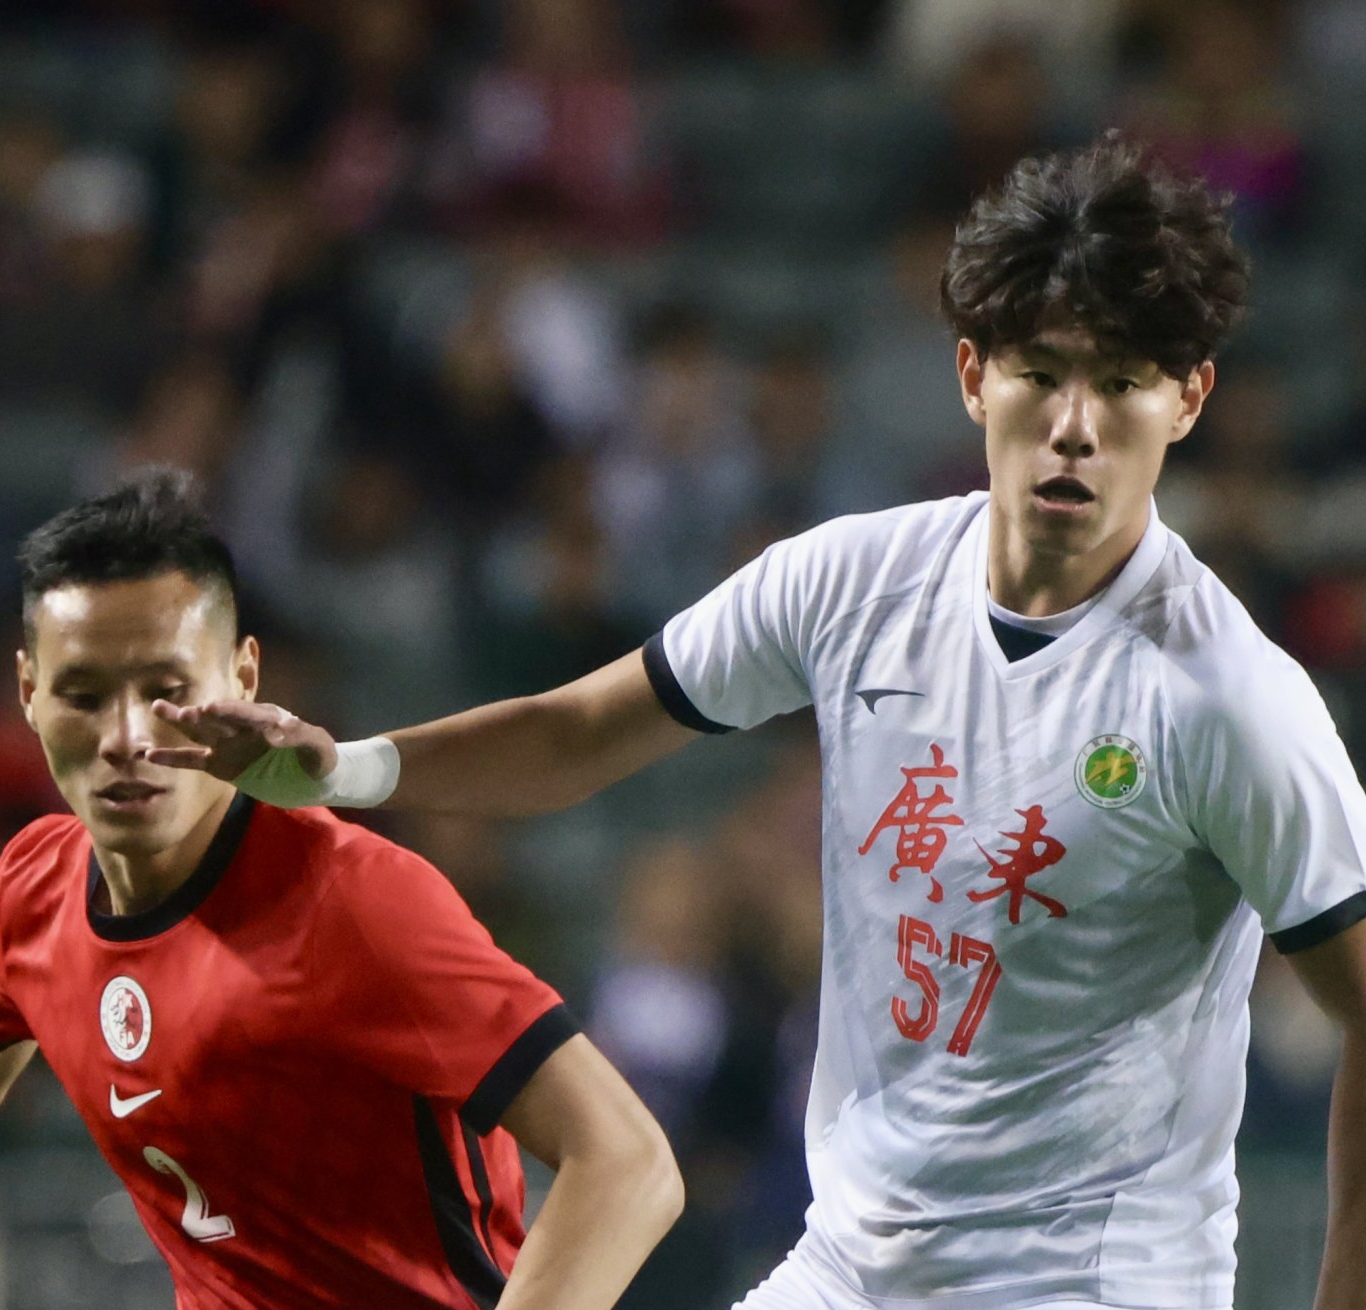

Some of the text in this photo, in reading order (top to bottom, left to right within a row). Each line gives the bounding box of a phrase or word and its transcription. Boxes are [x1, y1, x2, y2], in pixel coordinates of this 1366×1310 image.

[859, 744, 1066, 924] 廣東
[892, 914, 1001, 1057] 57
[143, 1146, 236, 1242] 2
